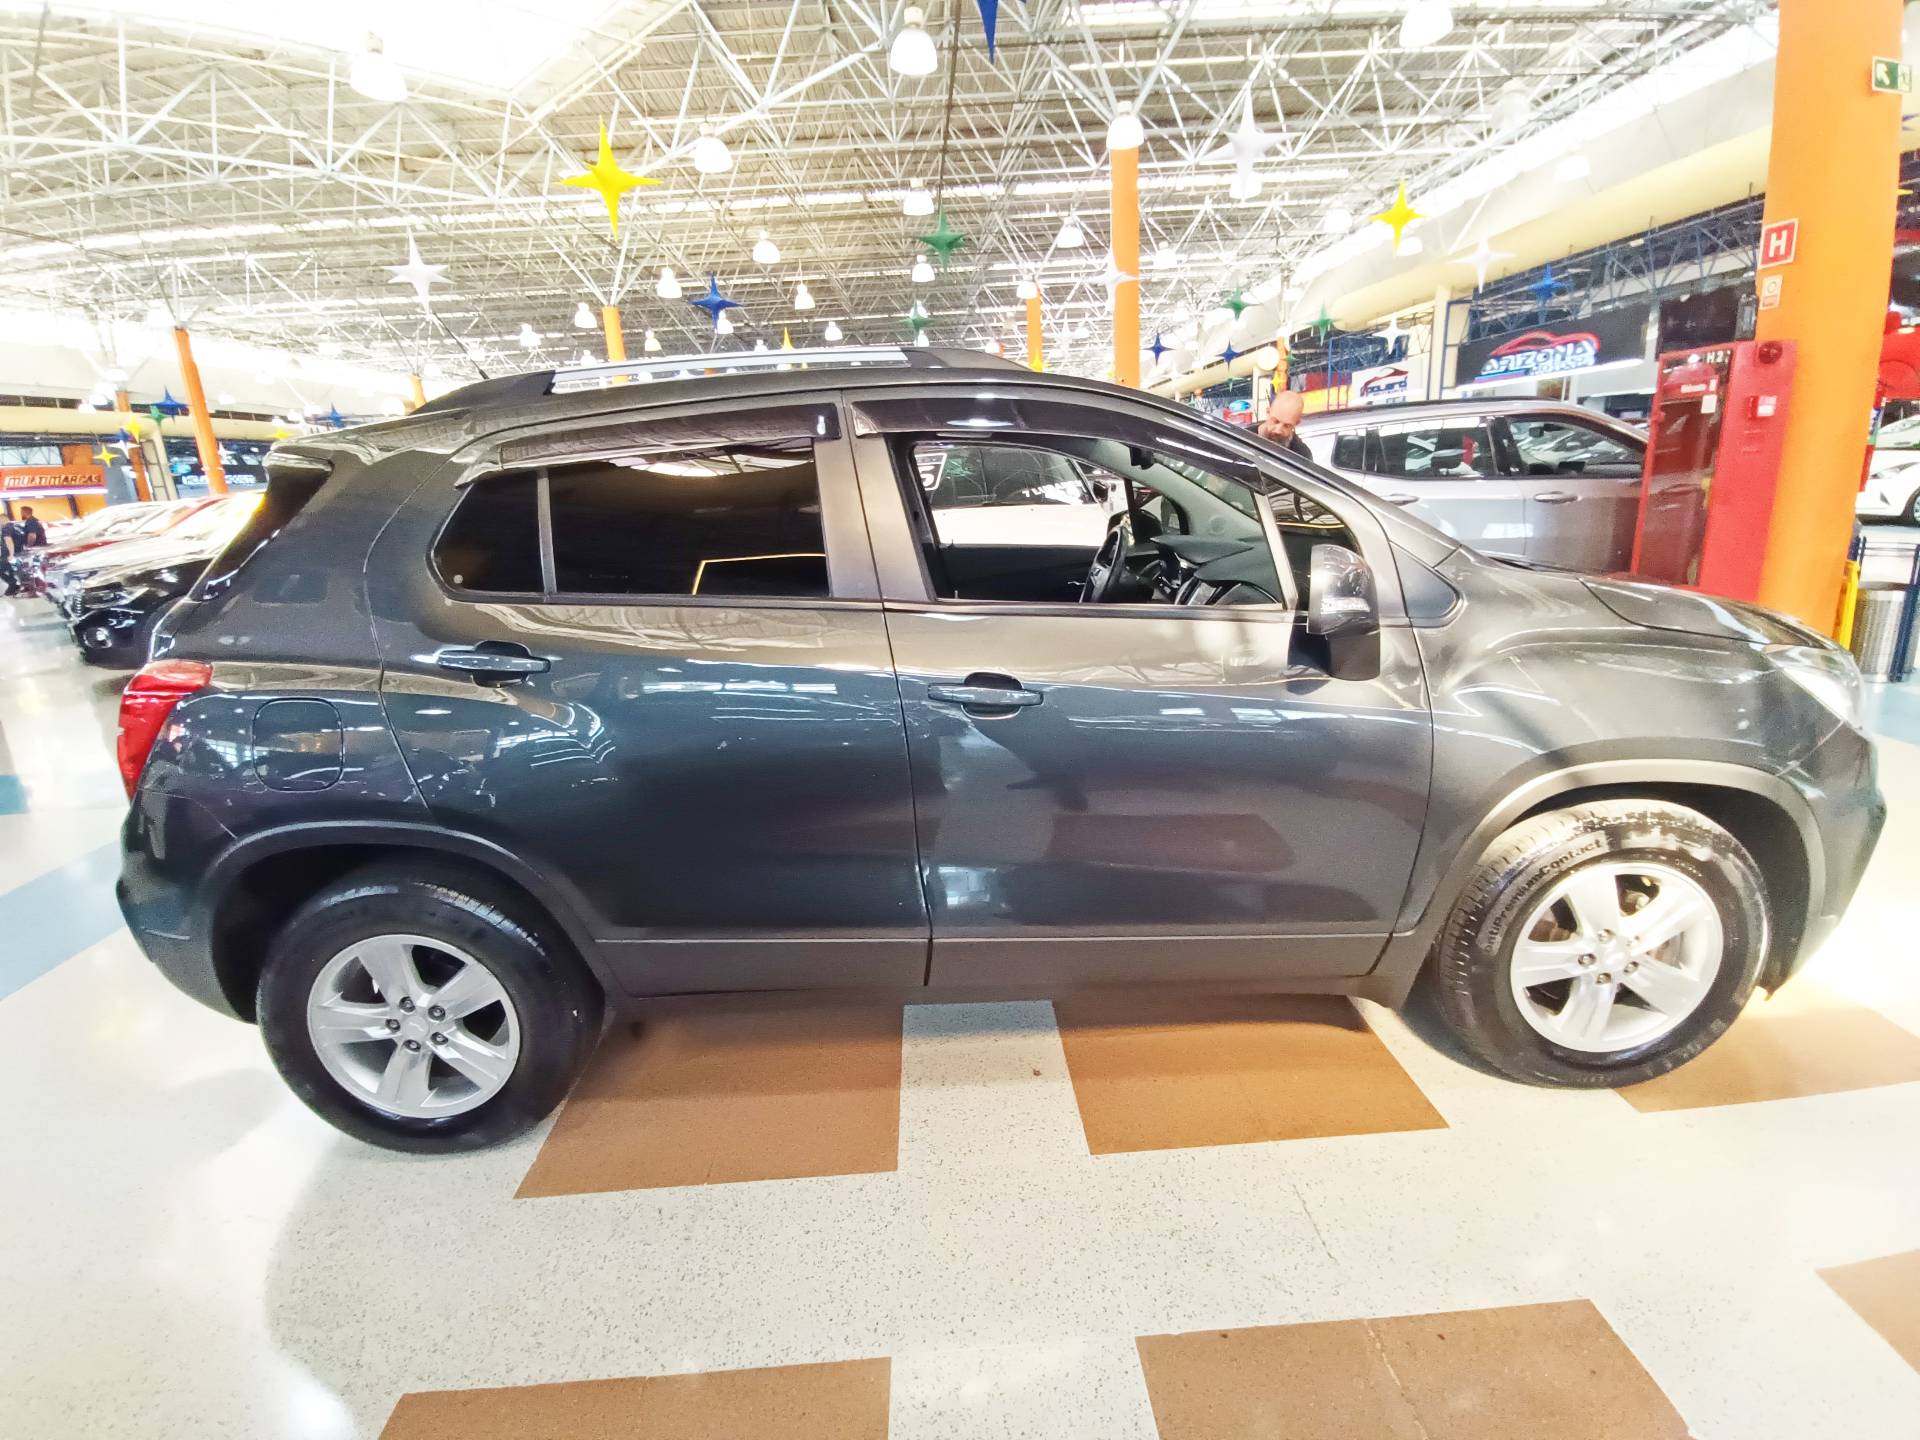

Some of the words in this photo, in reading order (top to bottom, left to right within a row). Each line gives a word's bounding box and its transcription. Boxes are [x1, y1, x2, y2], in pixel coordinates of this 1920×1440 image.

[1769, 229, 1788, 258] H
[1481, 340, 1595, 375] ARIZONA
[1484, 839, 1601, 953] ontiPremiumContact
